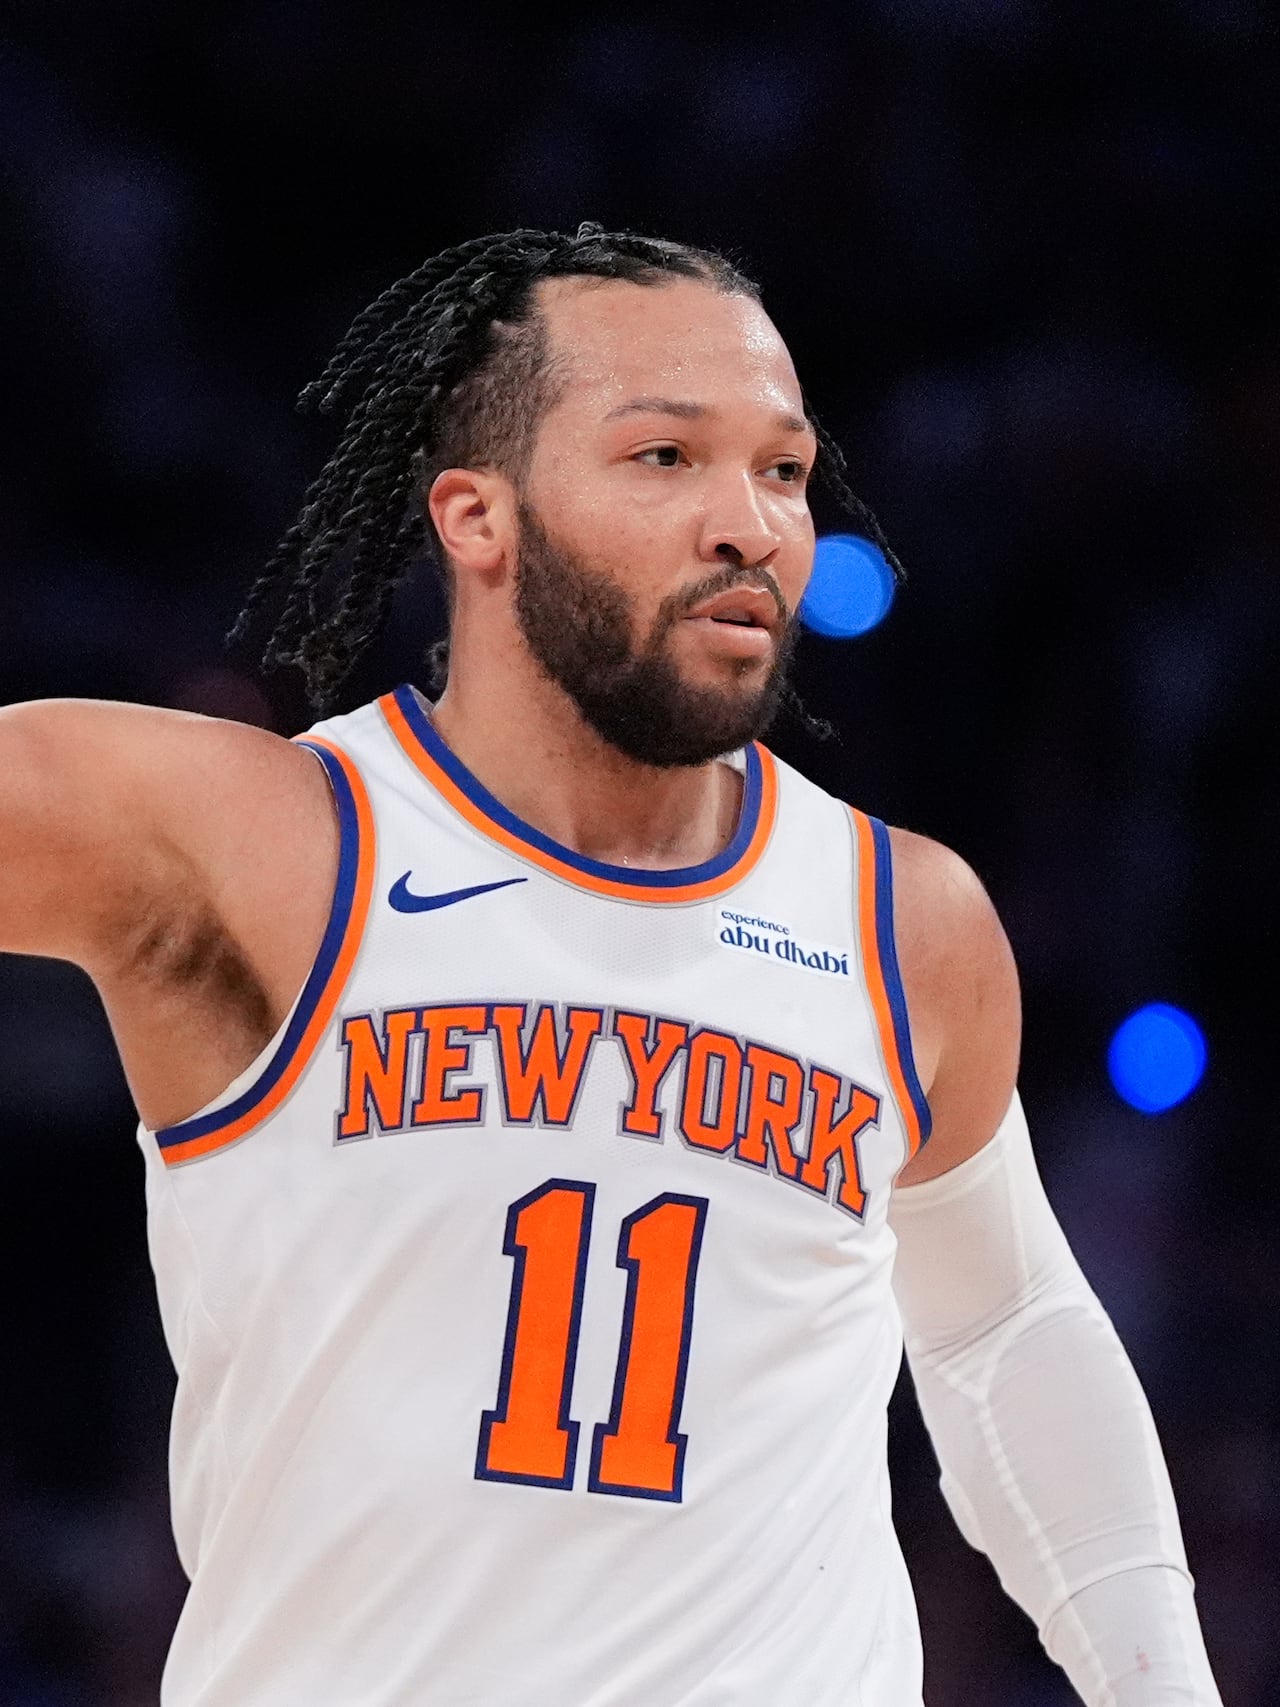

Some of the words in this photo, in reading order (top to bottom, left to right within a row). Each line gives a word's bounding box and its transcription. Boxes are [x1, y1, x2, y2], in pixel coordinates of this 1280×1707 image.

[720, 926, 770, 954] abu
[721, 910, 791, 935] experience
[333, 1000, 604, 1146] NEW
[613, 1006, 881, 1225] YORK
[474, 1178, 710, 1503] 11
